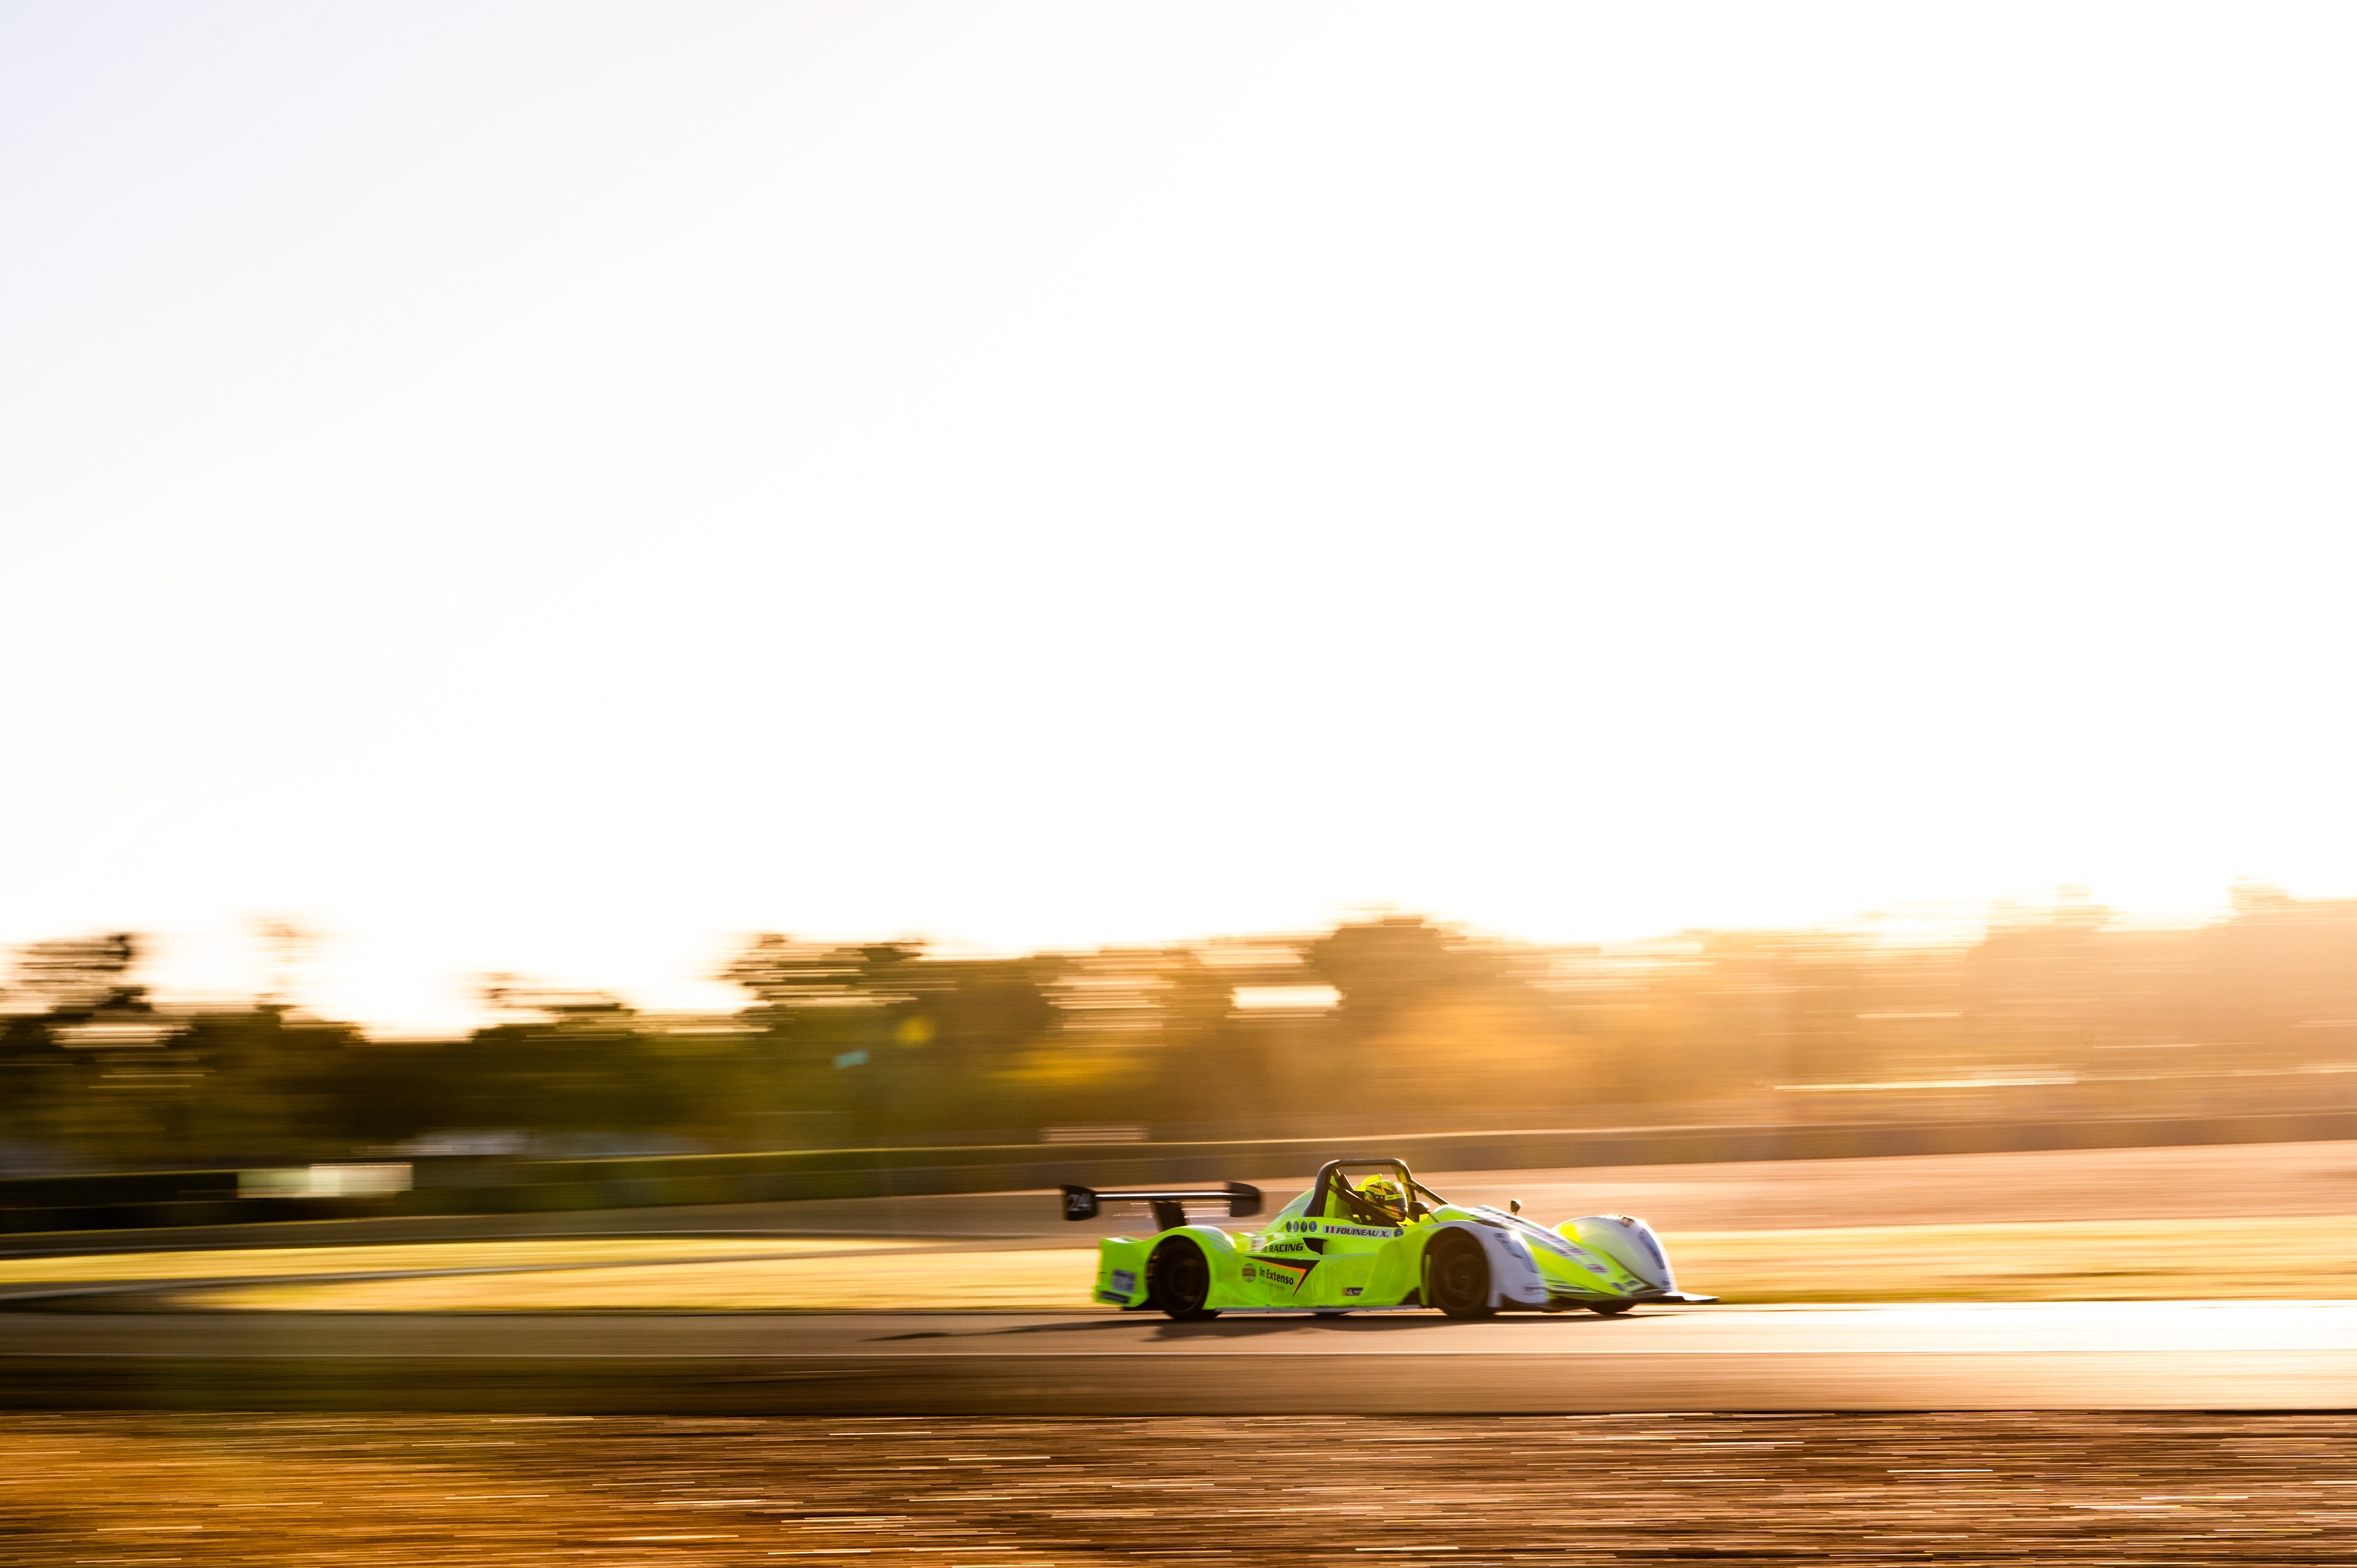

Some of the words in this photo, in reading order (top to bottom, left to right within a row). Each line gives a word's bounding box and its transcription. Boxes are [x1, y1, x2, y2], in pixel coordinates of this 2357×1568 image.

[1336, 1227, 1378, 1237] FOUINEAU
[1269, 1243, 1304, 1253] RACING
[1260, 1267, 1265, 1277] In
[1266, 1269, 1294, 1285] Extenso
